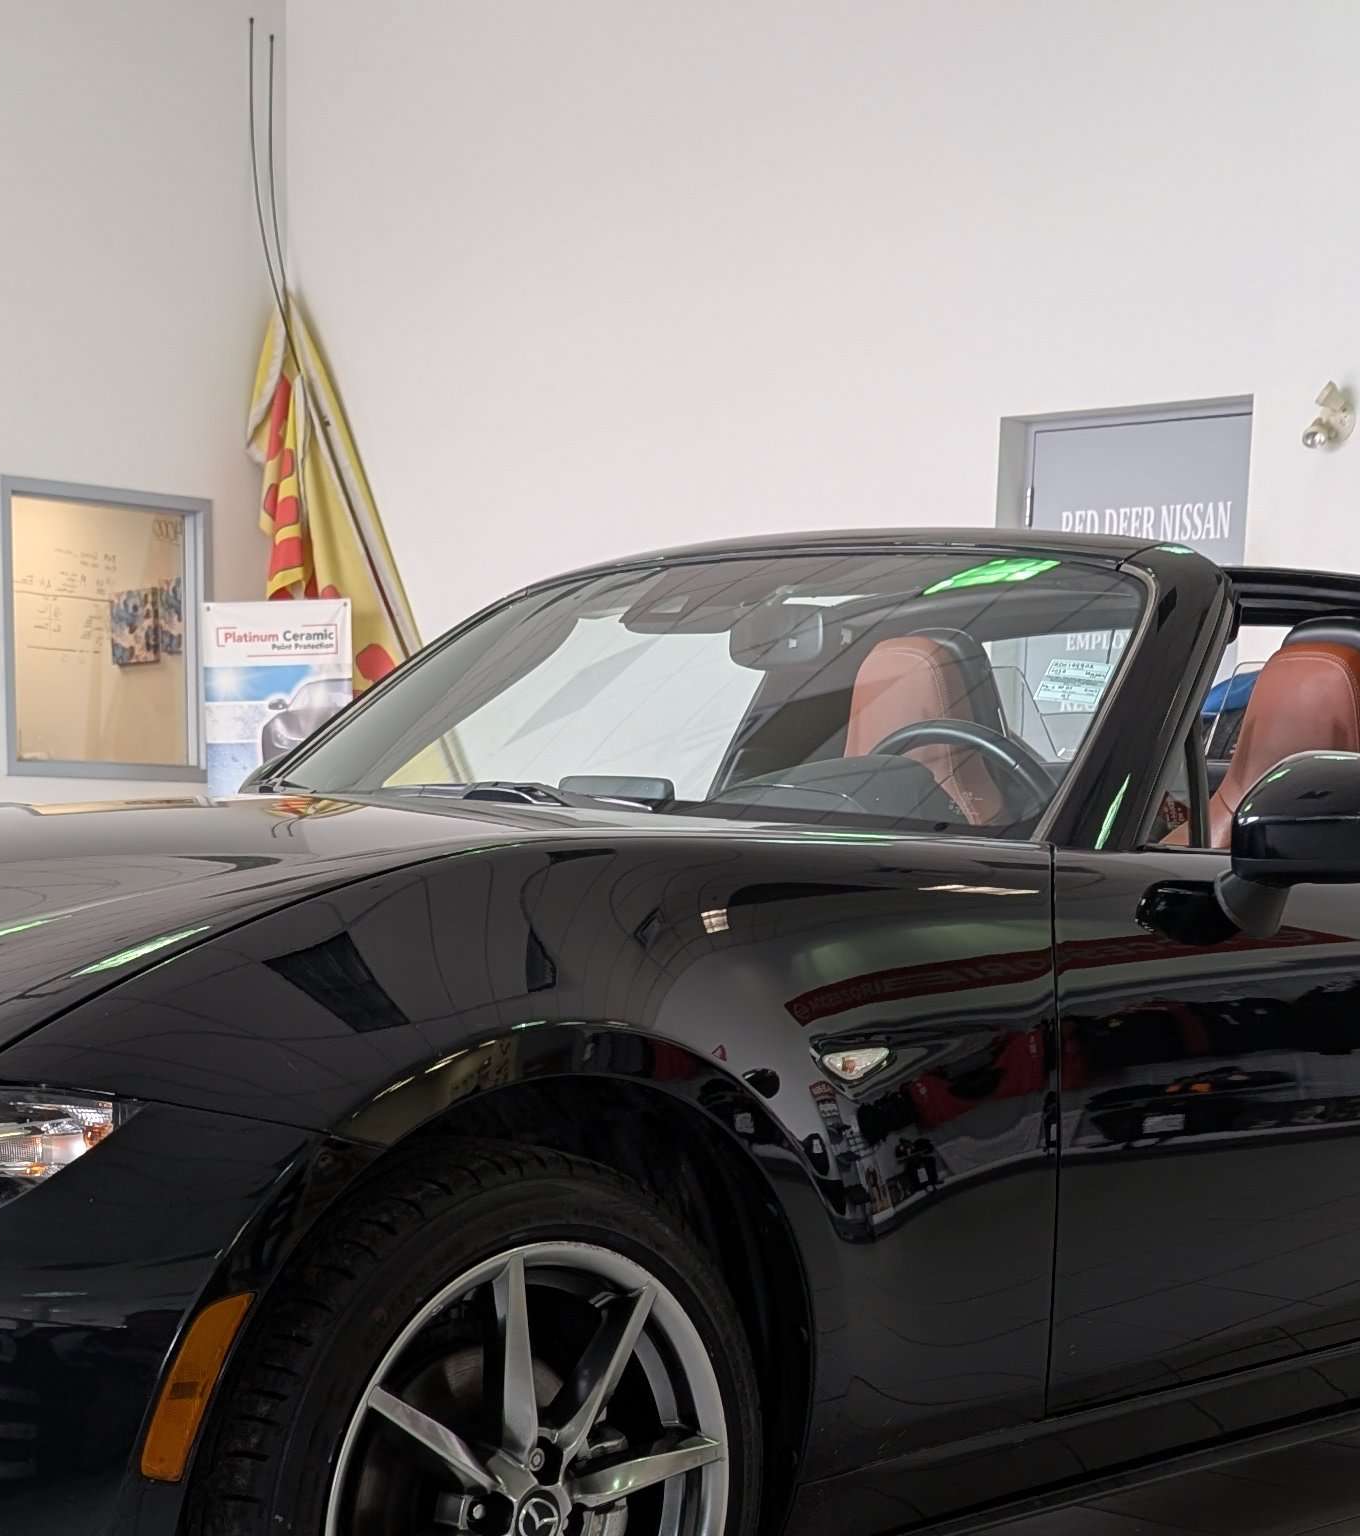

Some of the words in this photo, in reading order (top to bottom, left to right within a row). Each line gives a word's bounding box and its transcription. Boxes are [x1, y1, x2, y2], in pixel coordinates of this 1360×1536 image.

[1061, 510, 1099, 534] RED
[1104, 506, 1155, 541] DEER
[1160, 501, 1232, 542] NISSAN
[224, 631, 279, 643] Platinum
[283, 628, 334, 641] Ceramic
